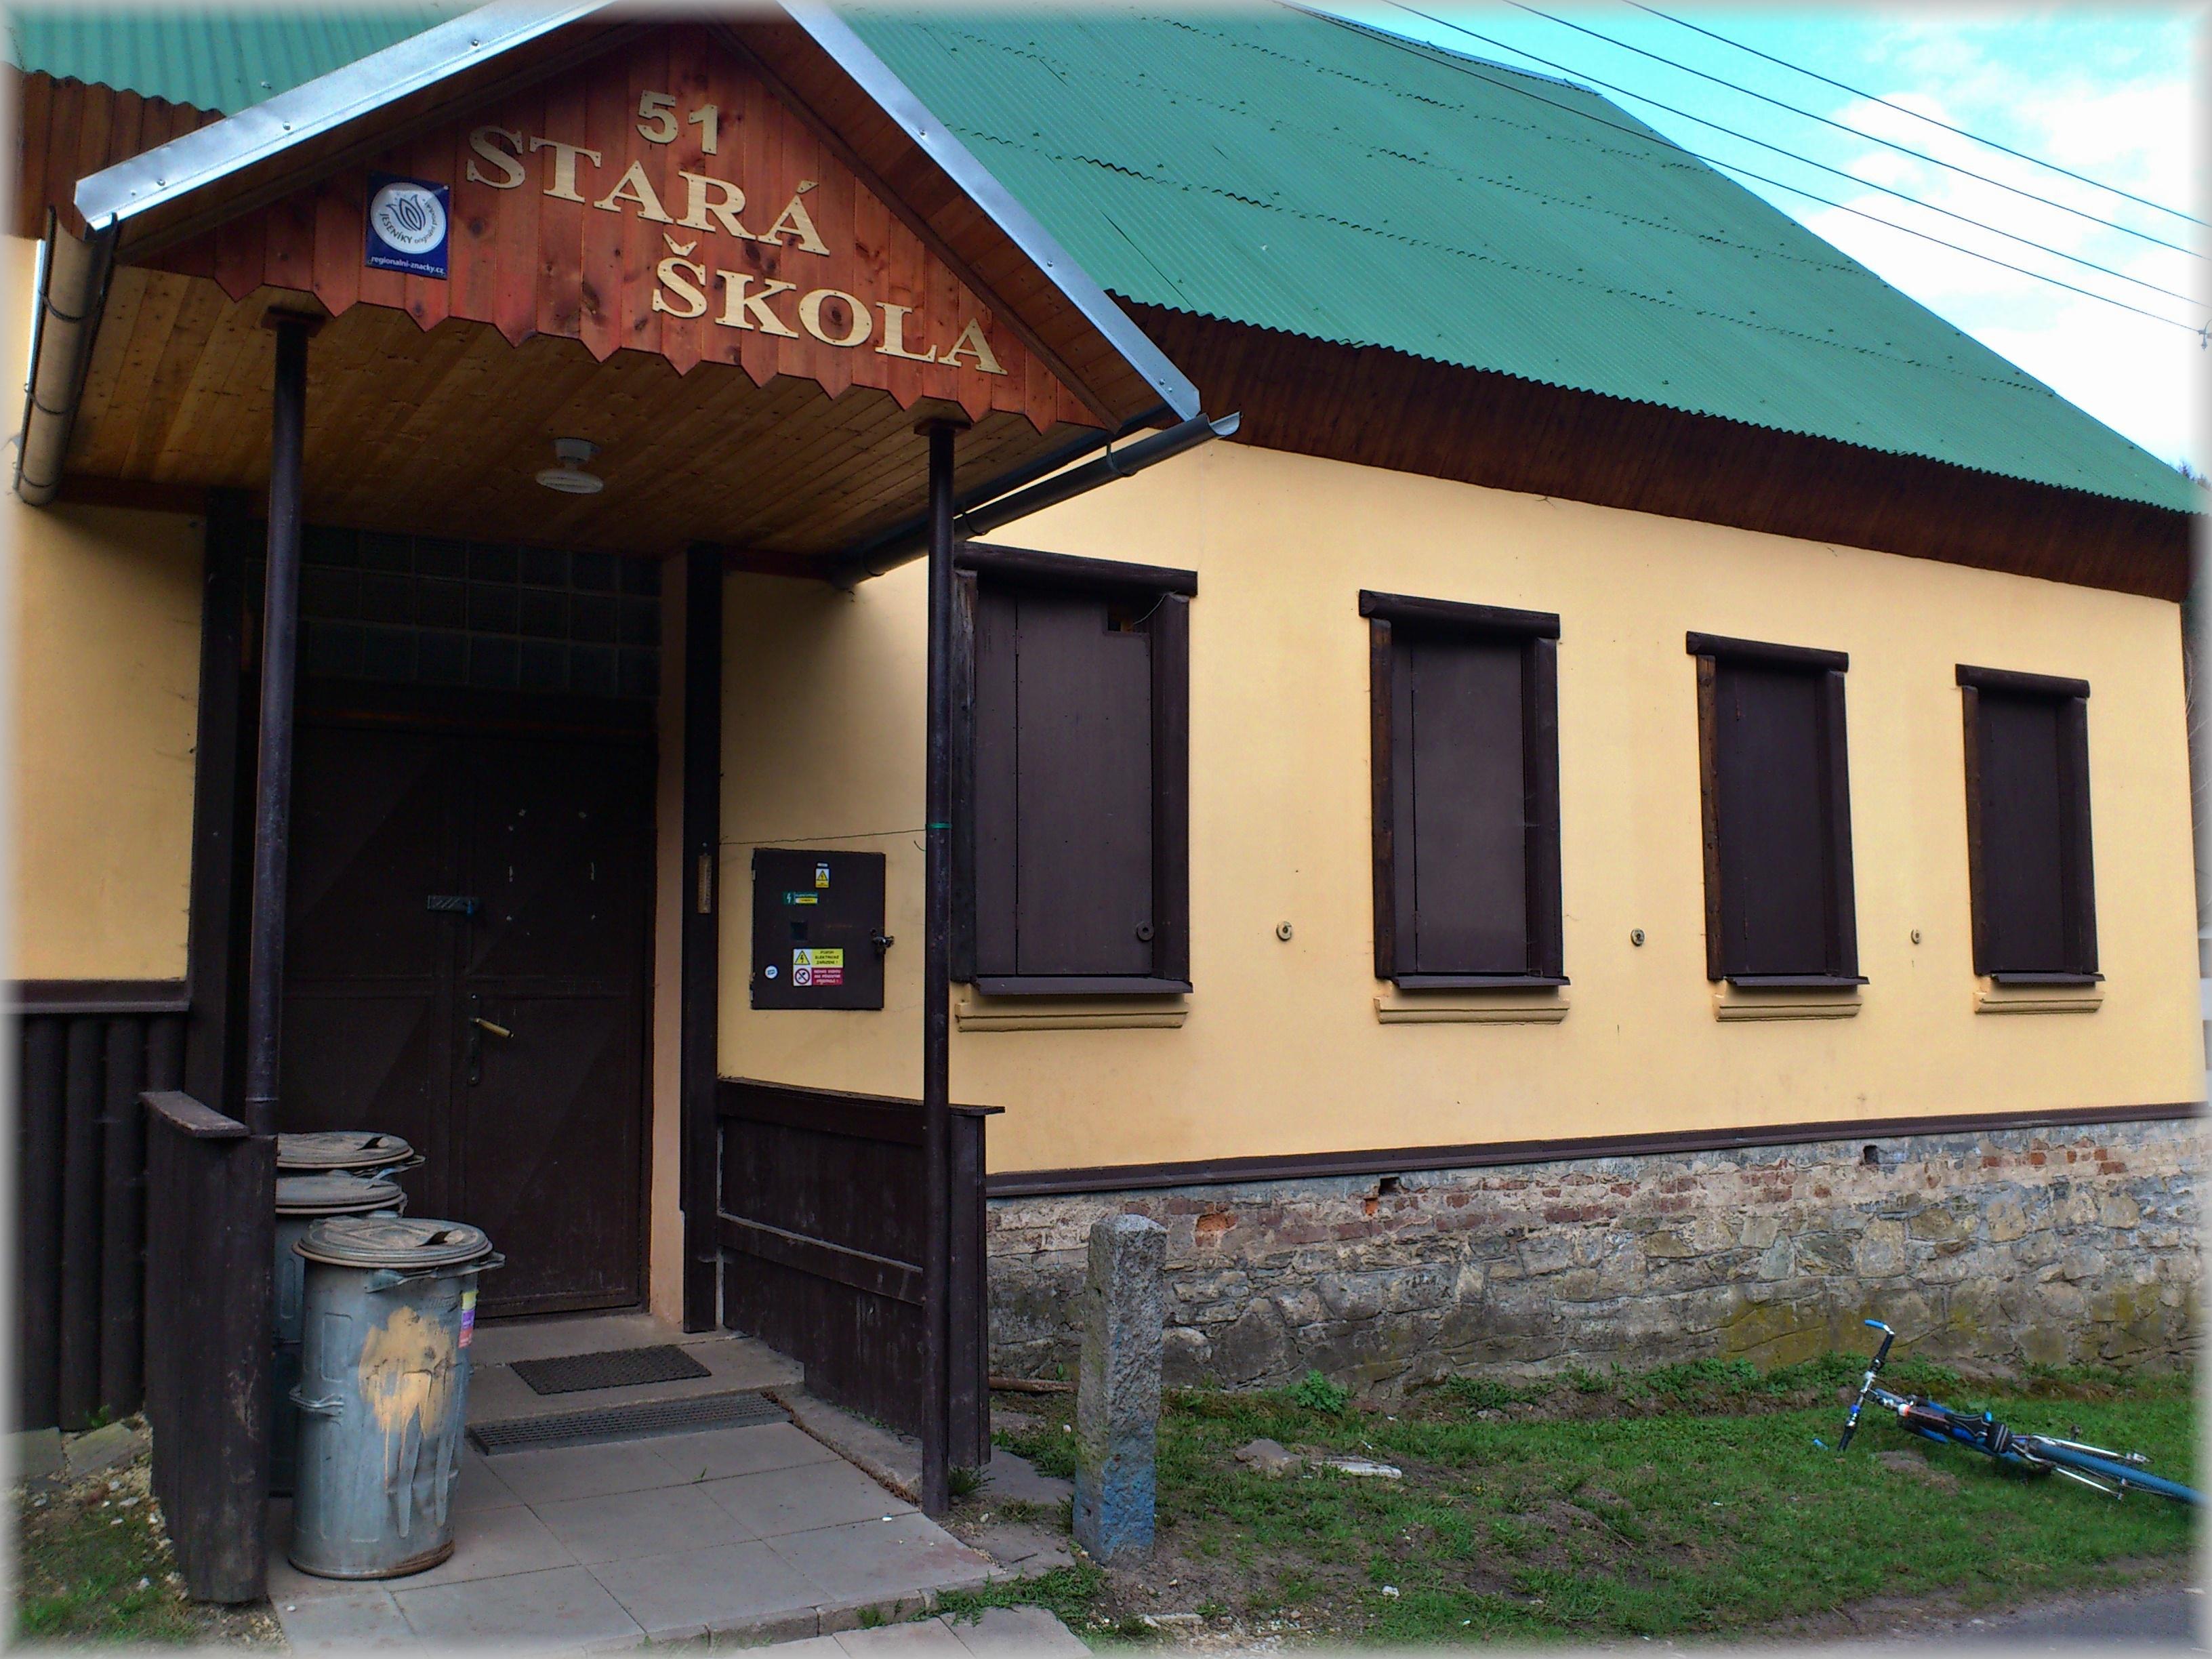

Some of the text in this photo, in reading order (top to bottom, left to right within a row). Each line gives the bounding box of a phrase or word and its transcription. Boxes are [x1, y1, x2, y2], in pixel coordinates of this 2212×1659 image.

[636, 89, 718, 155] 51
[466, 125, 831, 257] STARÁ
[380, 213, 413, 244] JESENÍKY
[371, 256, 445, 274] regionalni-znacky.cz
[651, 232, 1008, 376] ŠKOLA
